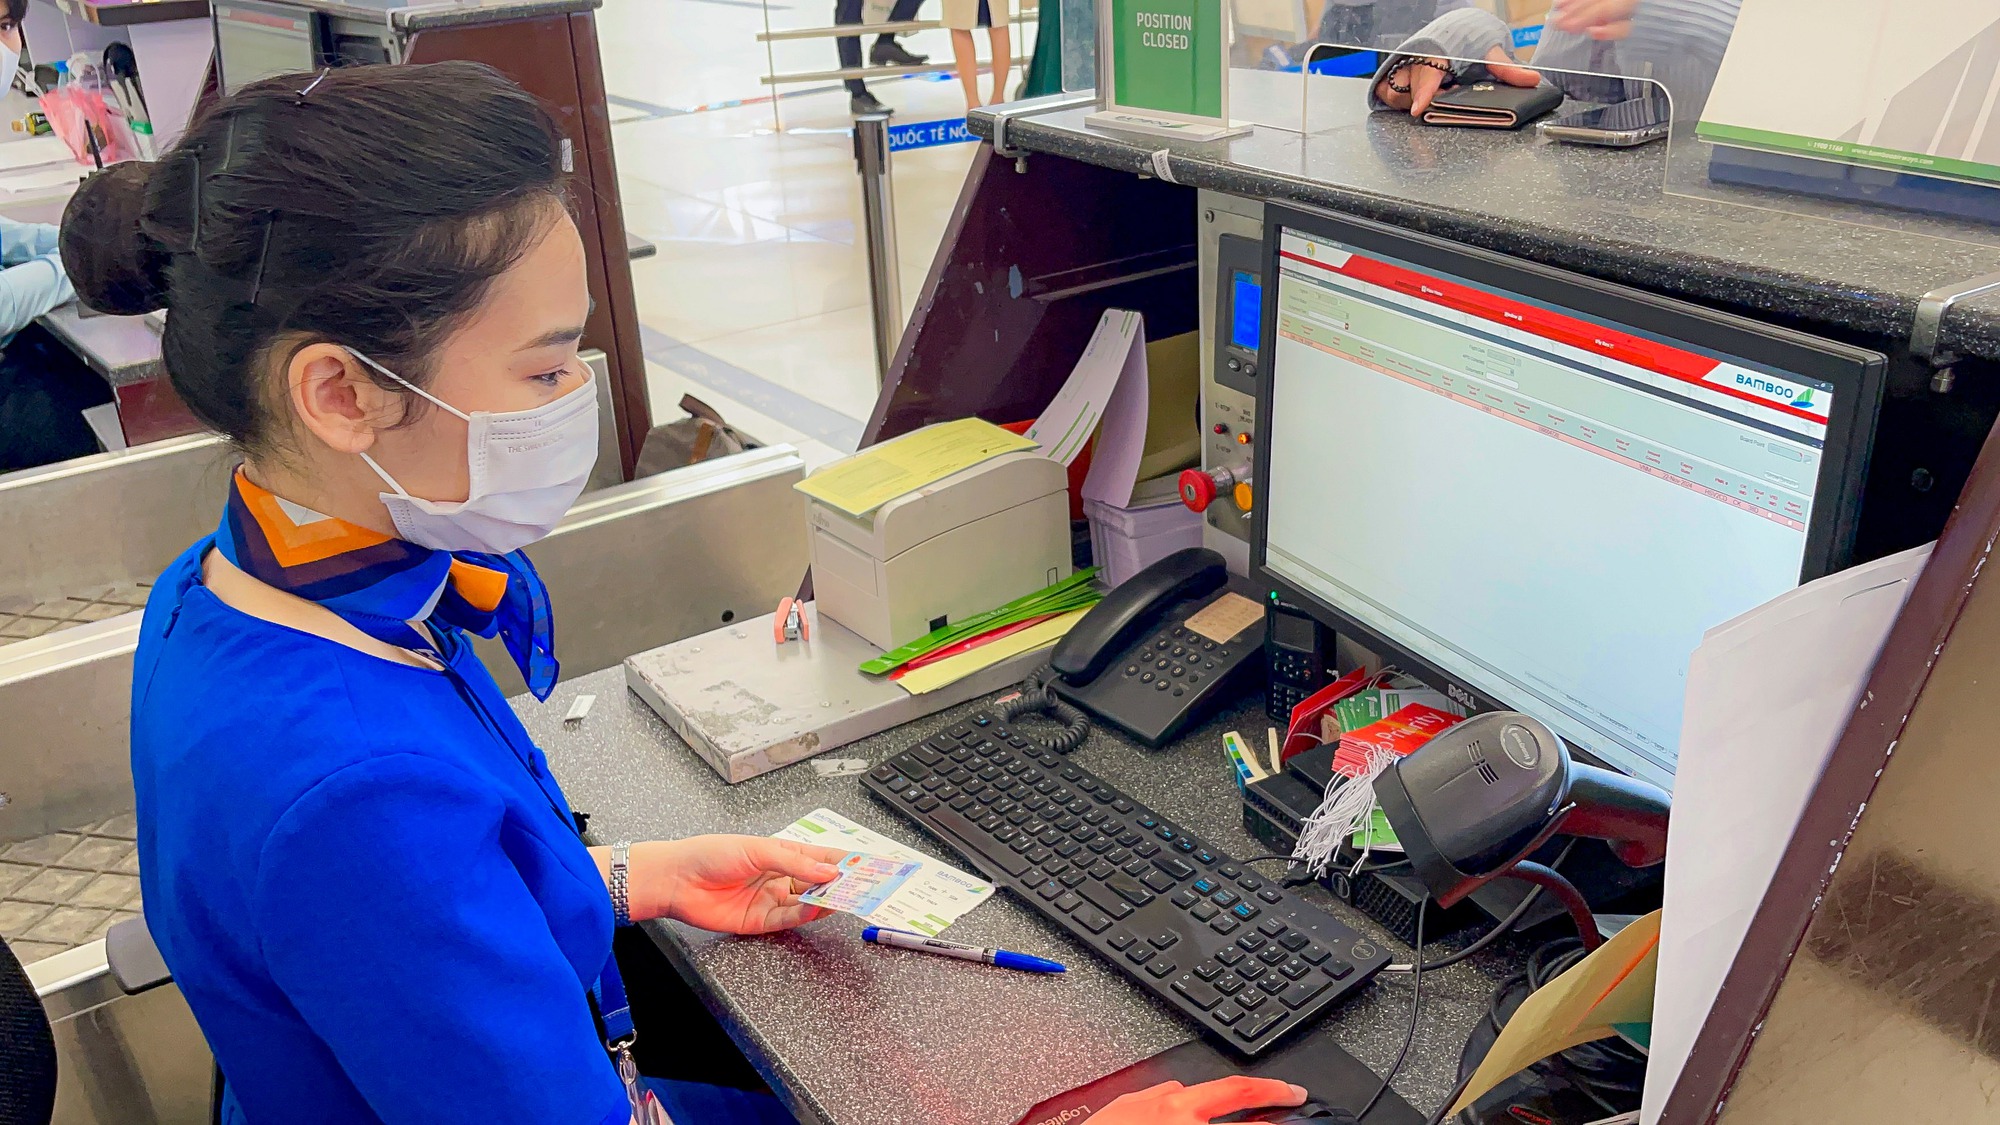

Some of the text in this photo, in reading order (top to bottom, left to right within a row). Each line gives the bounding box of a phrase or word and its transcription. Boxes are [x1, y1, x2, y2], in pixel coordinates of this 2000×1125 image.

[1136, 12, 1192, 31] POSITION
[1142, 32, 1188, 50] CLOSED
[930, 122, 947, 141] TẾ
[949, 122, 970, 141] NỘ
[1735, 373, 1794, 399] BAMBOO
[1447, 683, 1477, 711] DELL
[936, 870, 973, 888] BAMBOO
[1037, 1104, 1092, 1125] Logite
